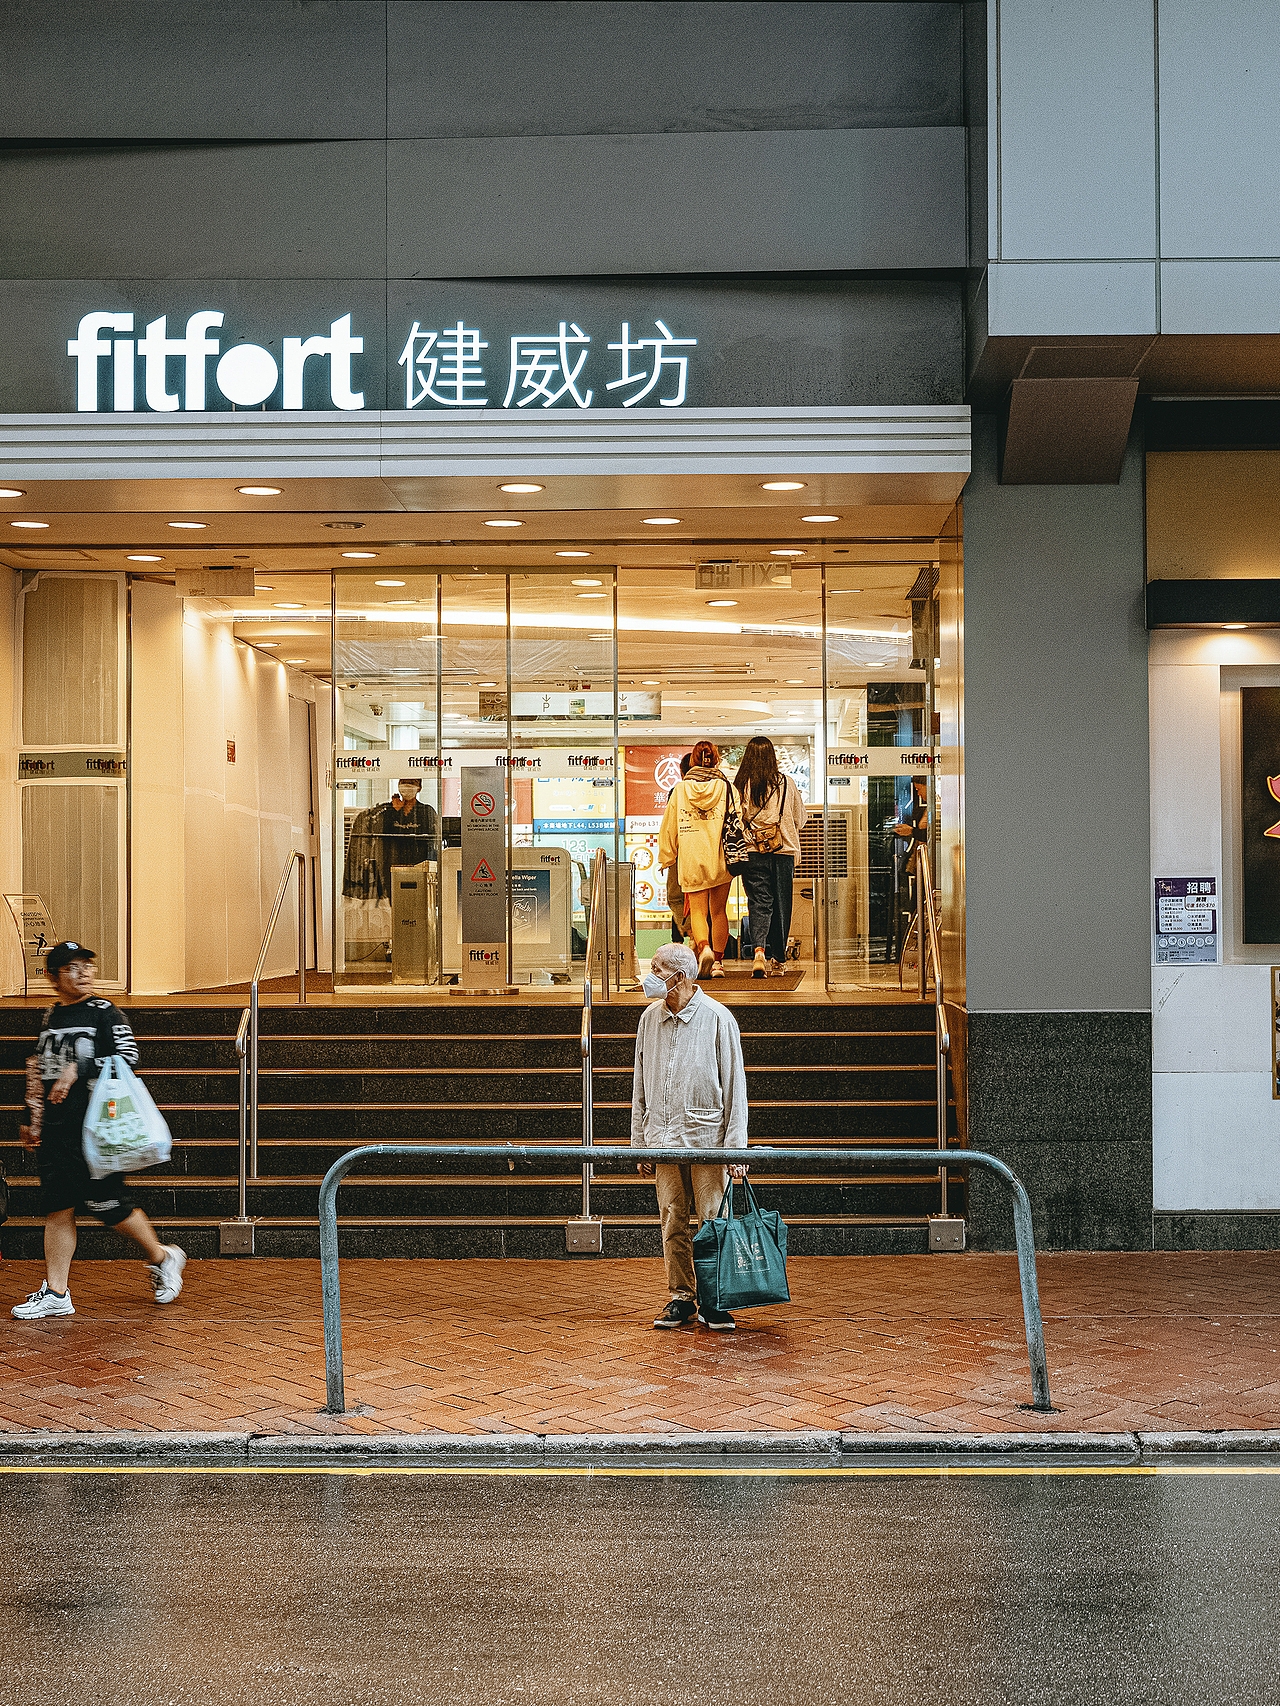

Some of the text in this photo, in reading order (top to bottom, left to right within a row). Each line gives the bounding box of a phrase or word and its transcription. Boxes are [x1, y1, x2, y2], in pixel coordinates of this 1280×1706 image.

[67, 310, 365, 412] fitfort
[397, 319, 698, 408] 健威坊
[1186, 882, 1211, 894] 招聘
[469, 950, 499, 960] fitfort
